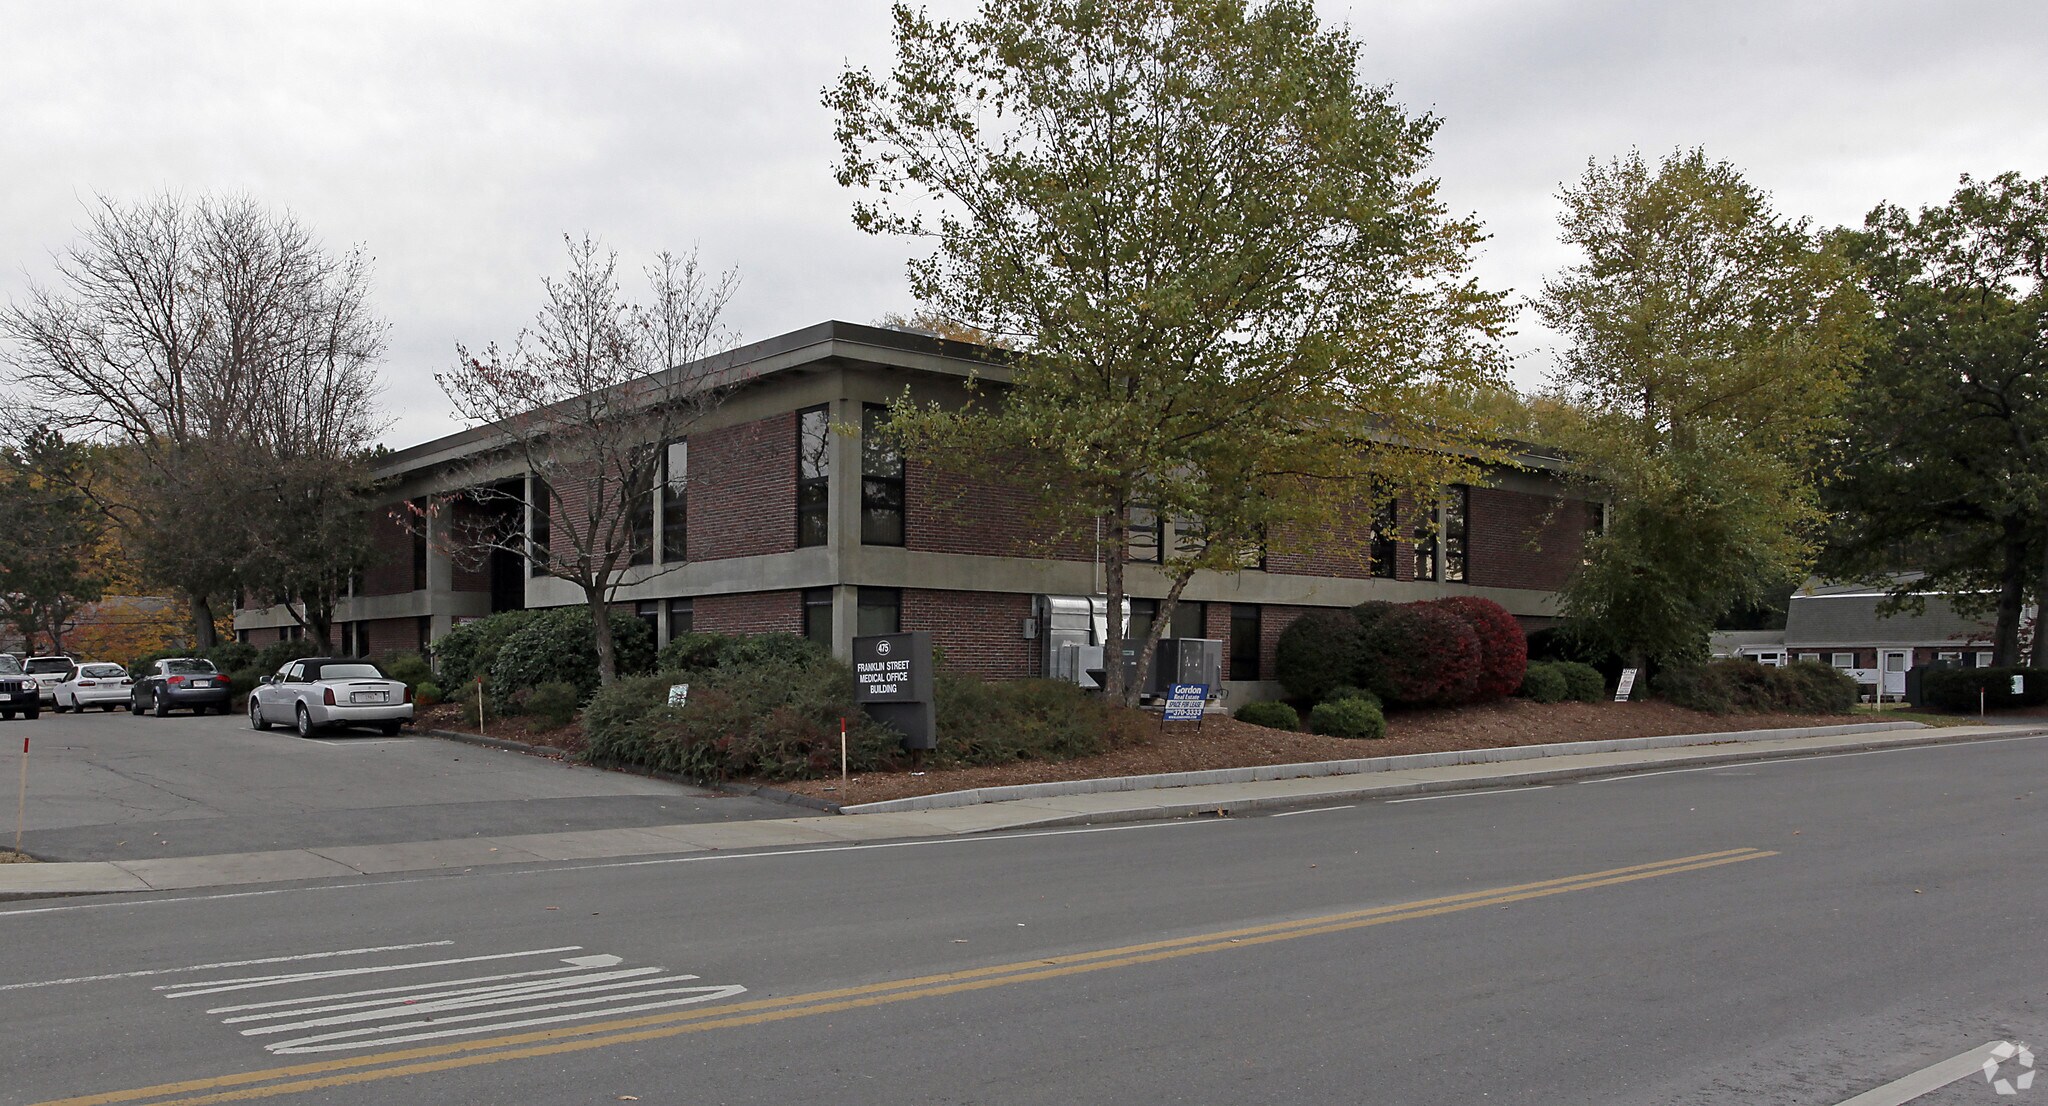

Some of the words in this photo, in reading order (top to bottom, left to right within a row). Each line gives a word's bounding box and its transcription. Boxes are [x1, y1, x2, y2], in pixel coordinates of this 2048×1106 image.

[878, 644, 889, 652] 475
[857, 662, 885, 672] FRANKLIN
[886, 660, 910, 670] STREET
[860, 674, 885, 683] MEDICAL
[886, 672, 908, 682] OFFICE
[870, 684, 897, 694] BUILDING
[1175, 685, 1202, 694] Gordon
